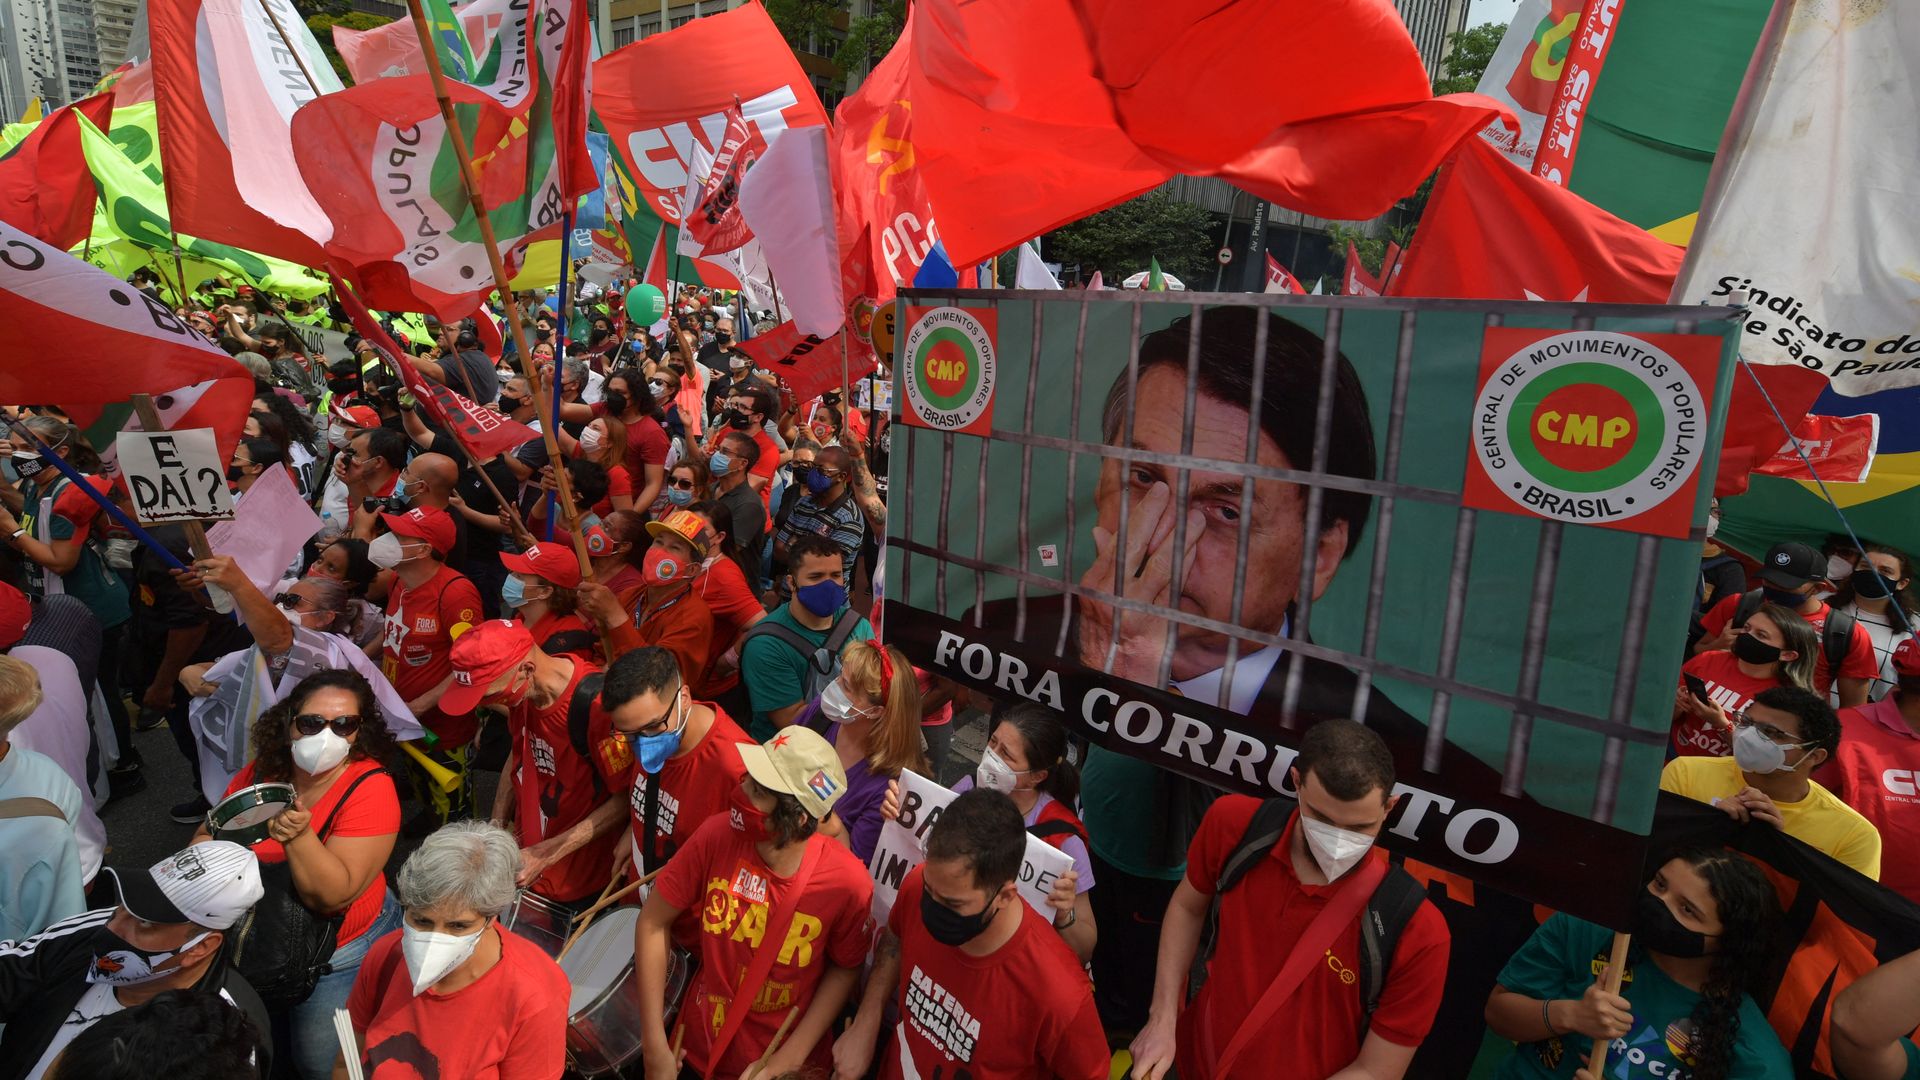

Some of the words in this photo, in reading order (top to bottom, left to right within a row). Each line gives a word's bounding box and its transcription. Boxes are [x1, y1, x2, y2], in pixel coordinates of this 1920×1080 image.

[1562, 63, 1579, 97] SÃO
[1548, 98, 1568, 149] PAULO
[1558, 69, 1590, 158] CUT
[1252, 202, 1264, 237] Paulista
[1712, 277, 1867, 353] Sindicato
[906, 349, 916, 398] CENTRAL
[911, 329, 922, 344] DE
[923, 312, 979, 336] MOVIMENTOS
[976, 337, 992, 407] POPULARES
[1772, 328, 1823, 370] São
[926, 358, 966, 381] CMP
[923, 408, 967, 427] BRASIL
[1482, 394, 1506, 470] CENTRAL
[1500, 363, 1526, 387] DE
[1529, 339, 1669, 378] MOVIMENTOS
[1650, 381, 1696, 491] POPULARES
[1537, 410, 1631, 448] CMP
[148, 436, 185, 469] E
[130, 467, 223, 512] DAÍ?
[1522, 485, 1623, 519] BRASIL
[416, 617, 436, 629] FORA
[933, 629, 1065, 712] FORA
[1081, 687, 1520, 864] CORRUTO
[732, 884, 766, 904] BOLSONARO
[736, 867, 768, 895] FORA
[908, 983, 949, 1025] ZUMBI
[949, 1018, 974, 1050] DOS
[911, 965, 981, 1041] BATERIA
[905, 993, 971, 1063] PALMARES
[921, 1029, 944, 1051] PAULO
